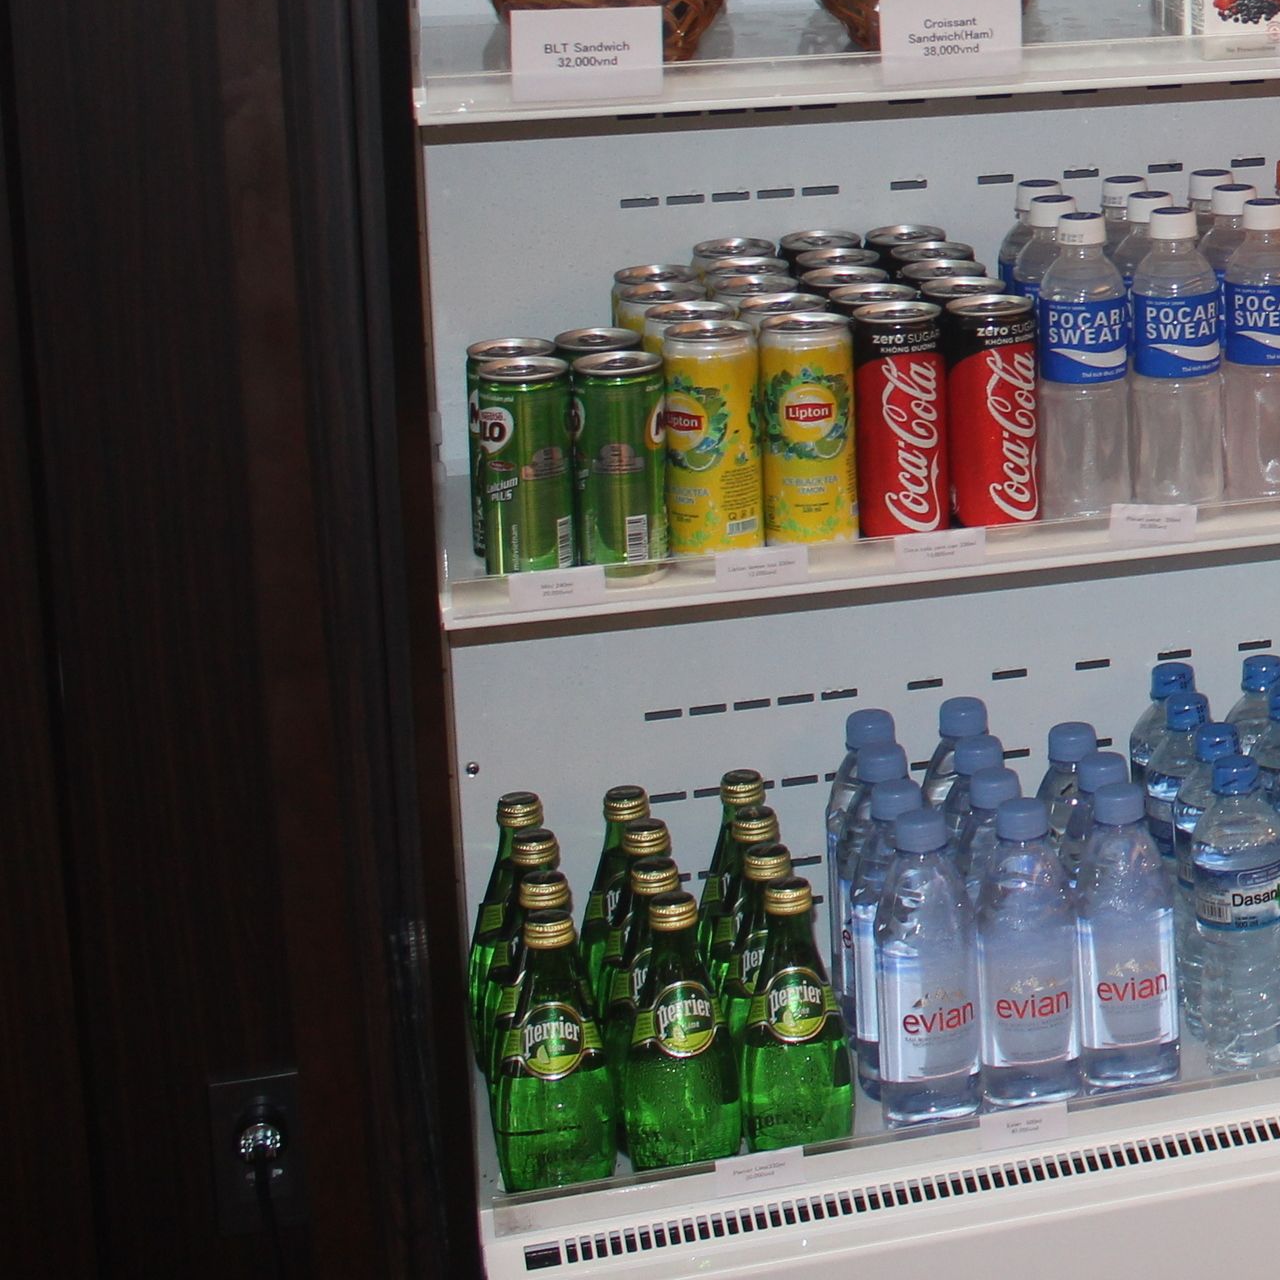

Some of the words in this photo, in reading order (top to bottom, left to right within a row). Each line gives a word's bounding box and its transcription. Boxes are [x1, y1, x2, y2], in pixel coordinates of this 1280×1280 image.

[923, 17, 977, 29] Croissant
[544, 43, 568, 54] BLT
[572, 40, 630, 54] Sandwich
[908, 28, 994, 44] Sandwich(Ham)
[923, 42, 980, 57] 38,000vnd
[558, 55, 618, 69] 32,000vnd
[1048, 306, 1125, 328] POCARI
[1146, 300, 1219, 322] POCARI
[976, 326, 1008, 338] zero
[1048, 323, 1122, 345] SWEAT
[1146, 316, 1217, 340] SWEAT
[872, 334, 904, 345] zero
[789, 406, 829, 420] Lipton
[882, 355, 941, 532] Coca-Cola
[986, 348, 1038, 521] Coca-Cola
[1232, 888, 1280, 908] Dasani
[1096, 972, 1168, 1003] evian
[768, 983, 822, 1024] perrier
[996, 990, 1069, 1020] evian
[656, 993, 711, 1041] perrier
[902, 1001, 974, 1035] evian
[523, 1020, 580, 1062] perrier
